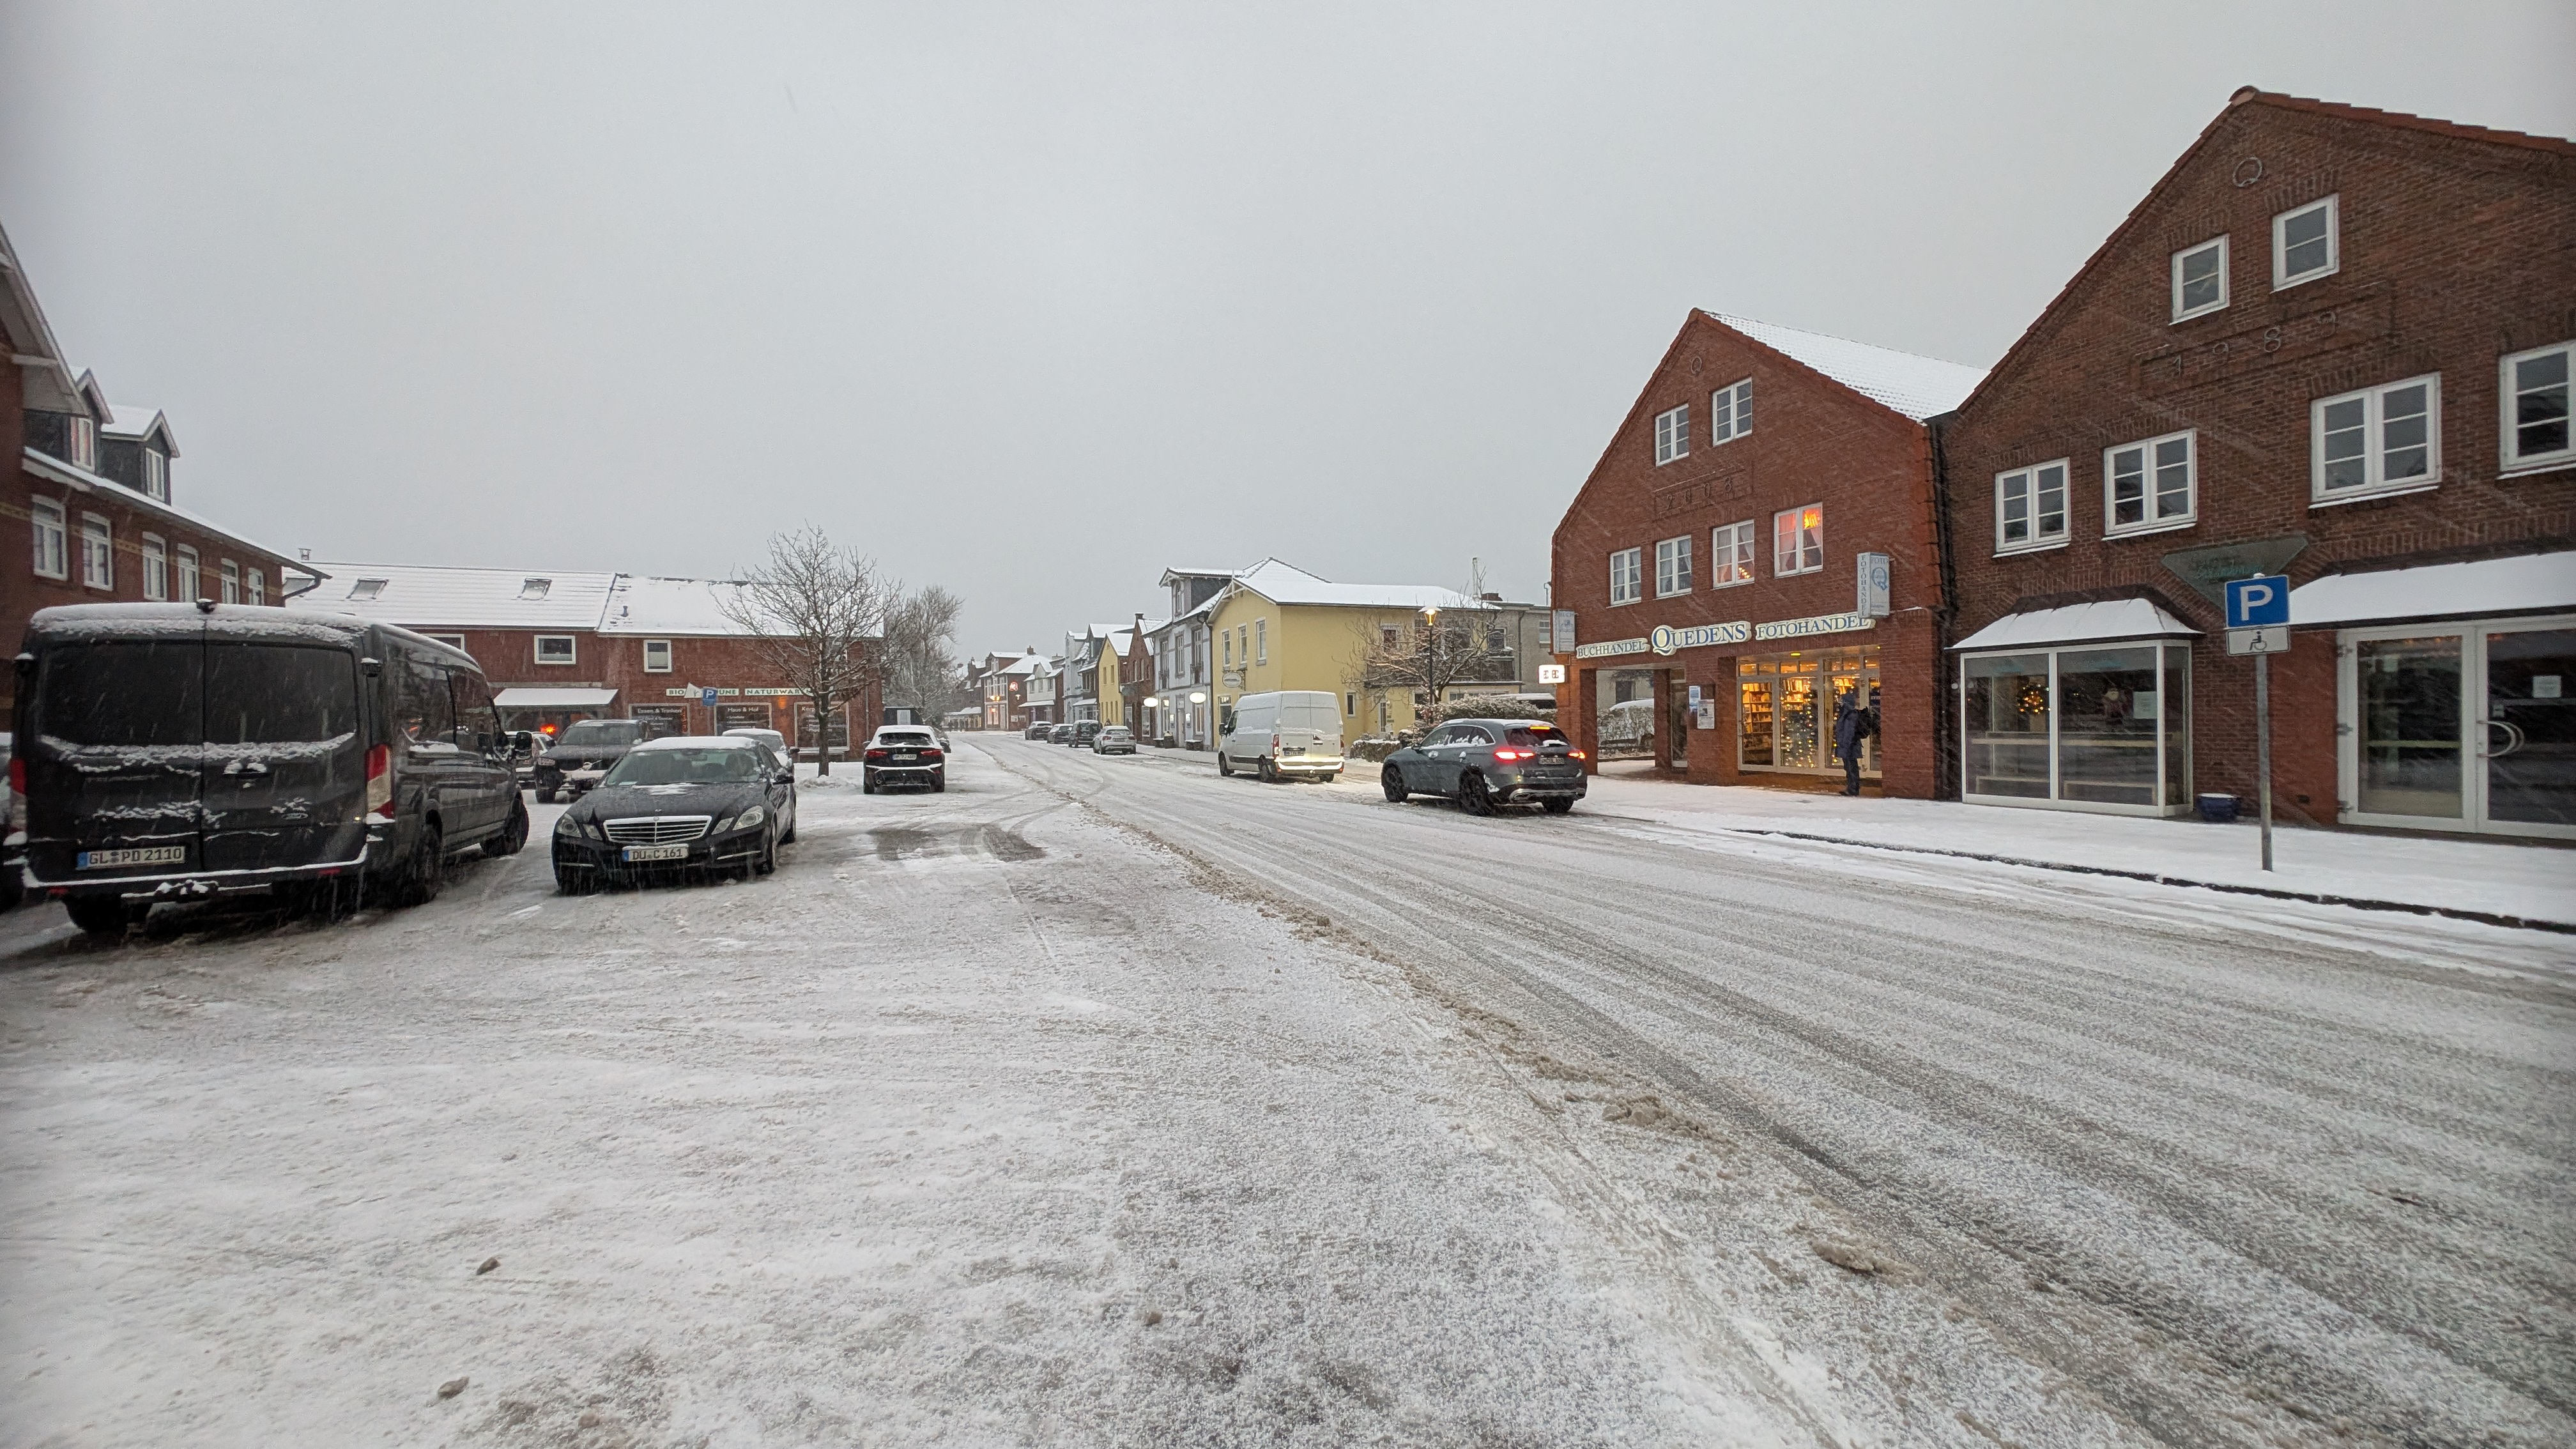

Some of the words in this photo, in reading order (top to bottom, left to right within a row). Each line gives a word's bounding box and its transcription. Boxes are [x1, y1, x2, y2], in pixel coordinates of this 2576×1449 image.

[2173, 309, 2337, 376] 1989
[2239, 585, 2274, 621] P
[1577, 640, 1646, 657] BUCHHANDEL
[1652, 623, 1747, 654] QUEDENS
[1757, 615, 1869, 639] FOTOHANDEL
[705, 689, 714, 698] P
[89, 853, 108, 864] GL
[144, 848, 182, 861] 2110
[653, 850, 661, 859] C
[663, 848, 683, 858] 161
